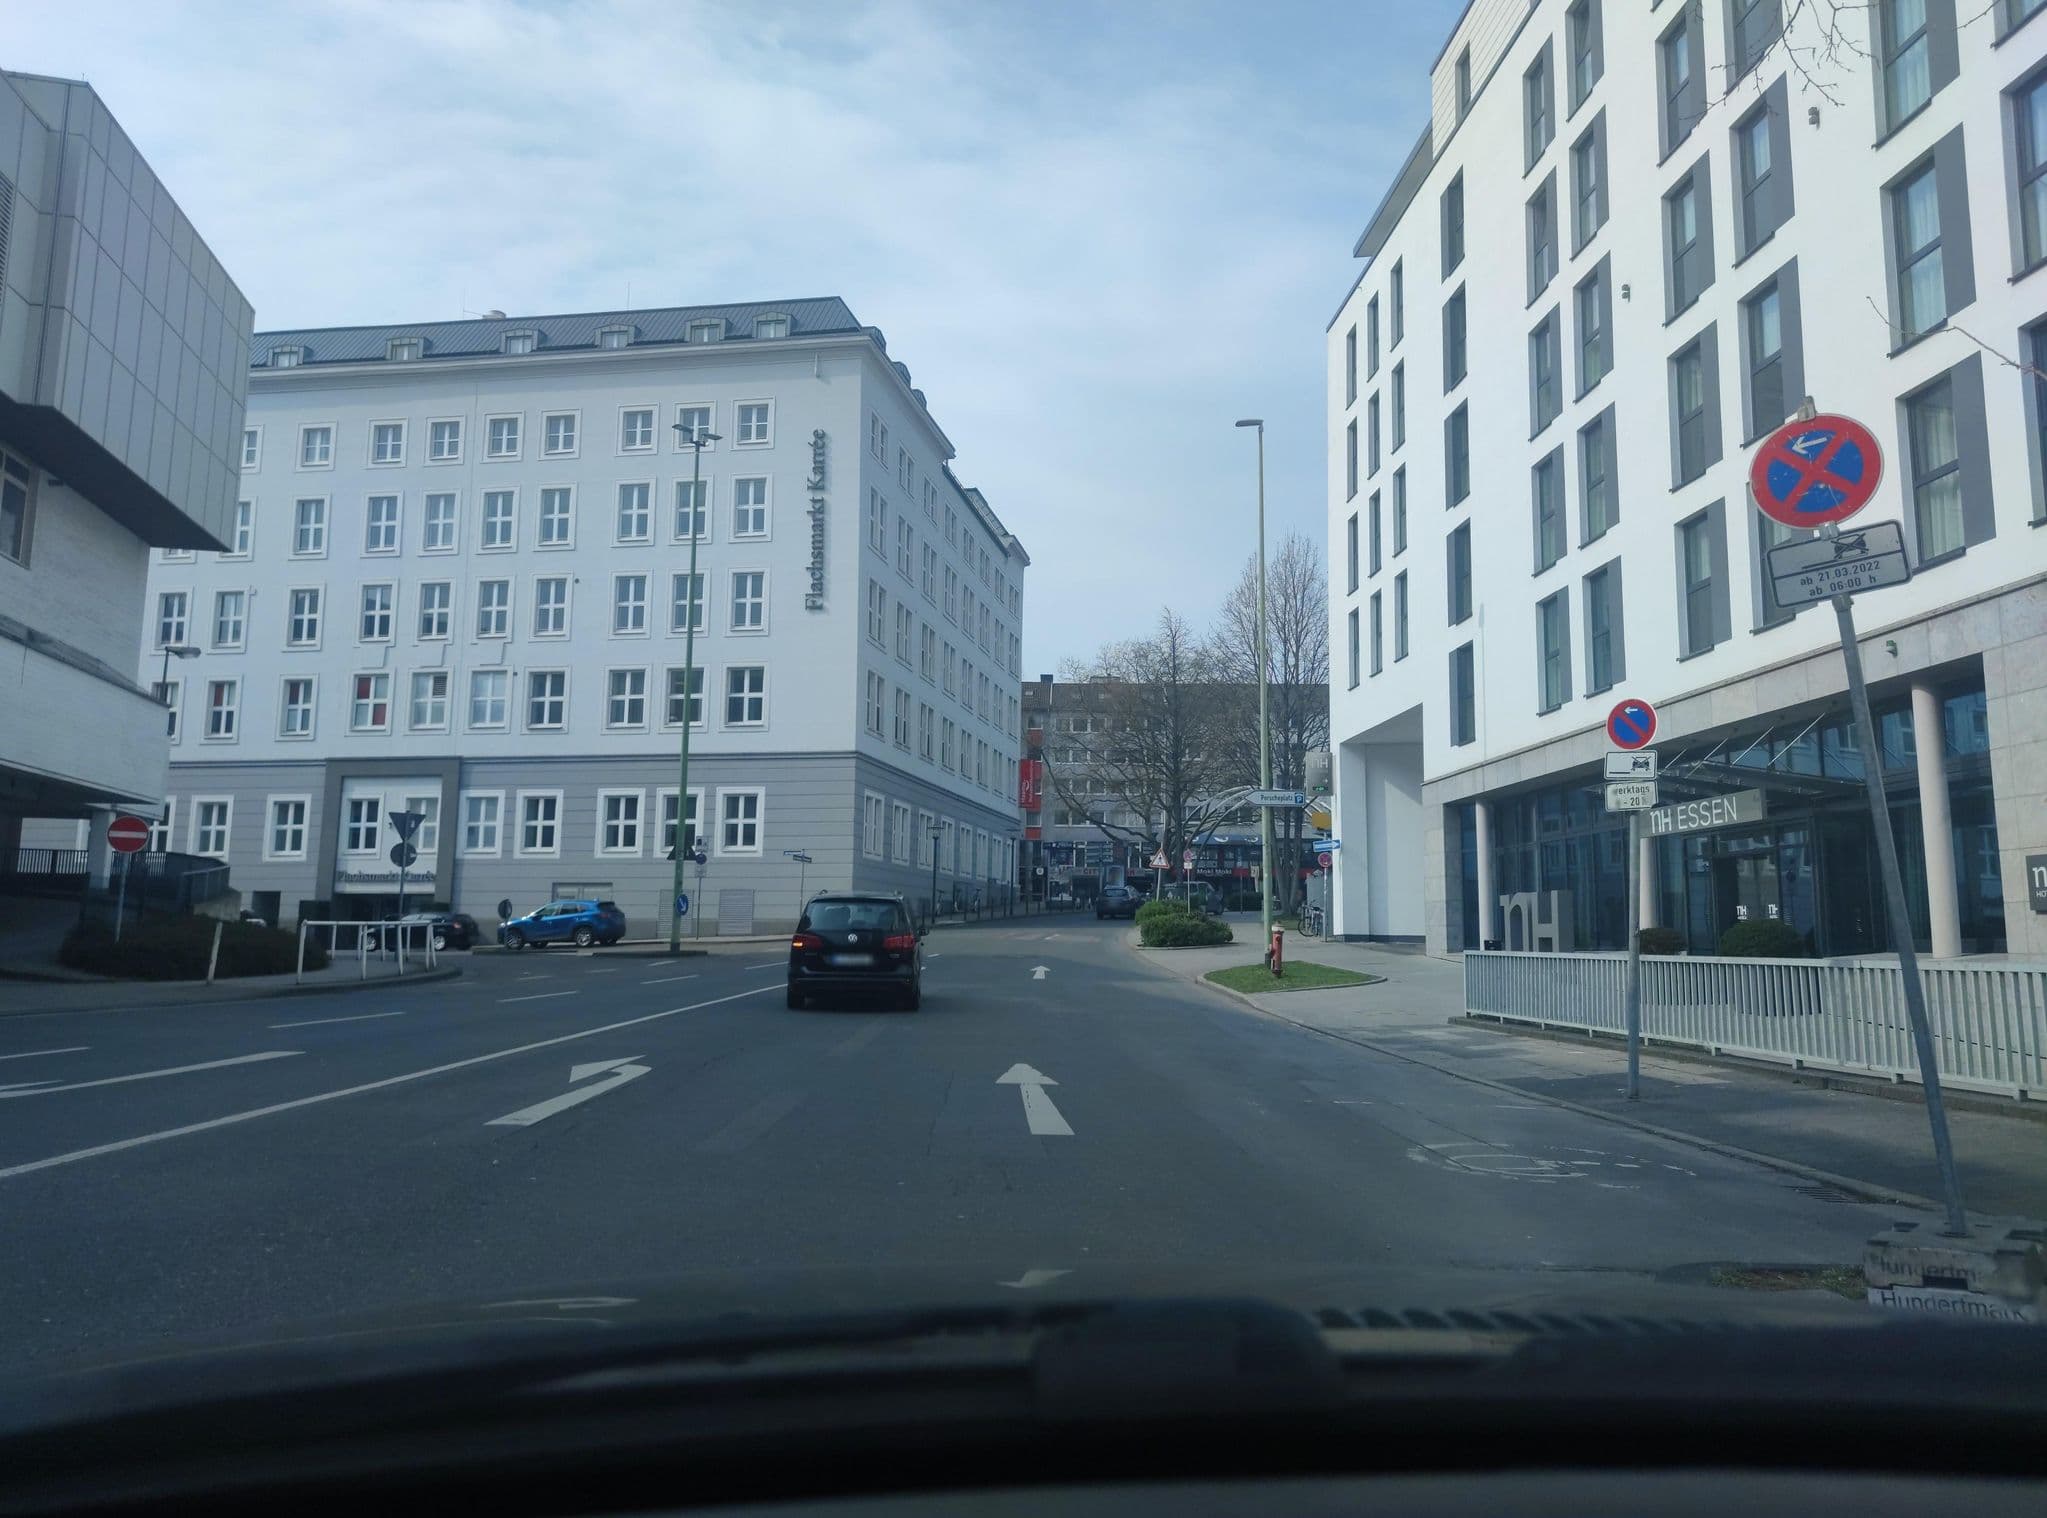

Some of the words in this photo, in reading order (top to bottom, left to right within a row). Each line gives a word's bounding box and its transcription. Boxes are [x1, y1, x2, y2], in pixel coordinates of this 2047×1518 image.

[804, 497, 825, 611] Flachsmarkt
[1800, 577, 1813, 586] ab
[1818, 560, 1880, 581] 21.03.2022
[1809, 585, 1823, 597] ab
[1829, 577, 1862, 592] 06:00
[1869, 574, 1877, 584] h
[1614, 785, 1650, 796] erktags
[1677, 796, 1737, 830] ESSEN
